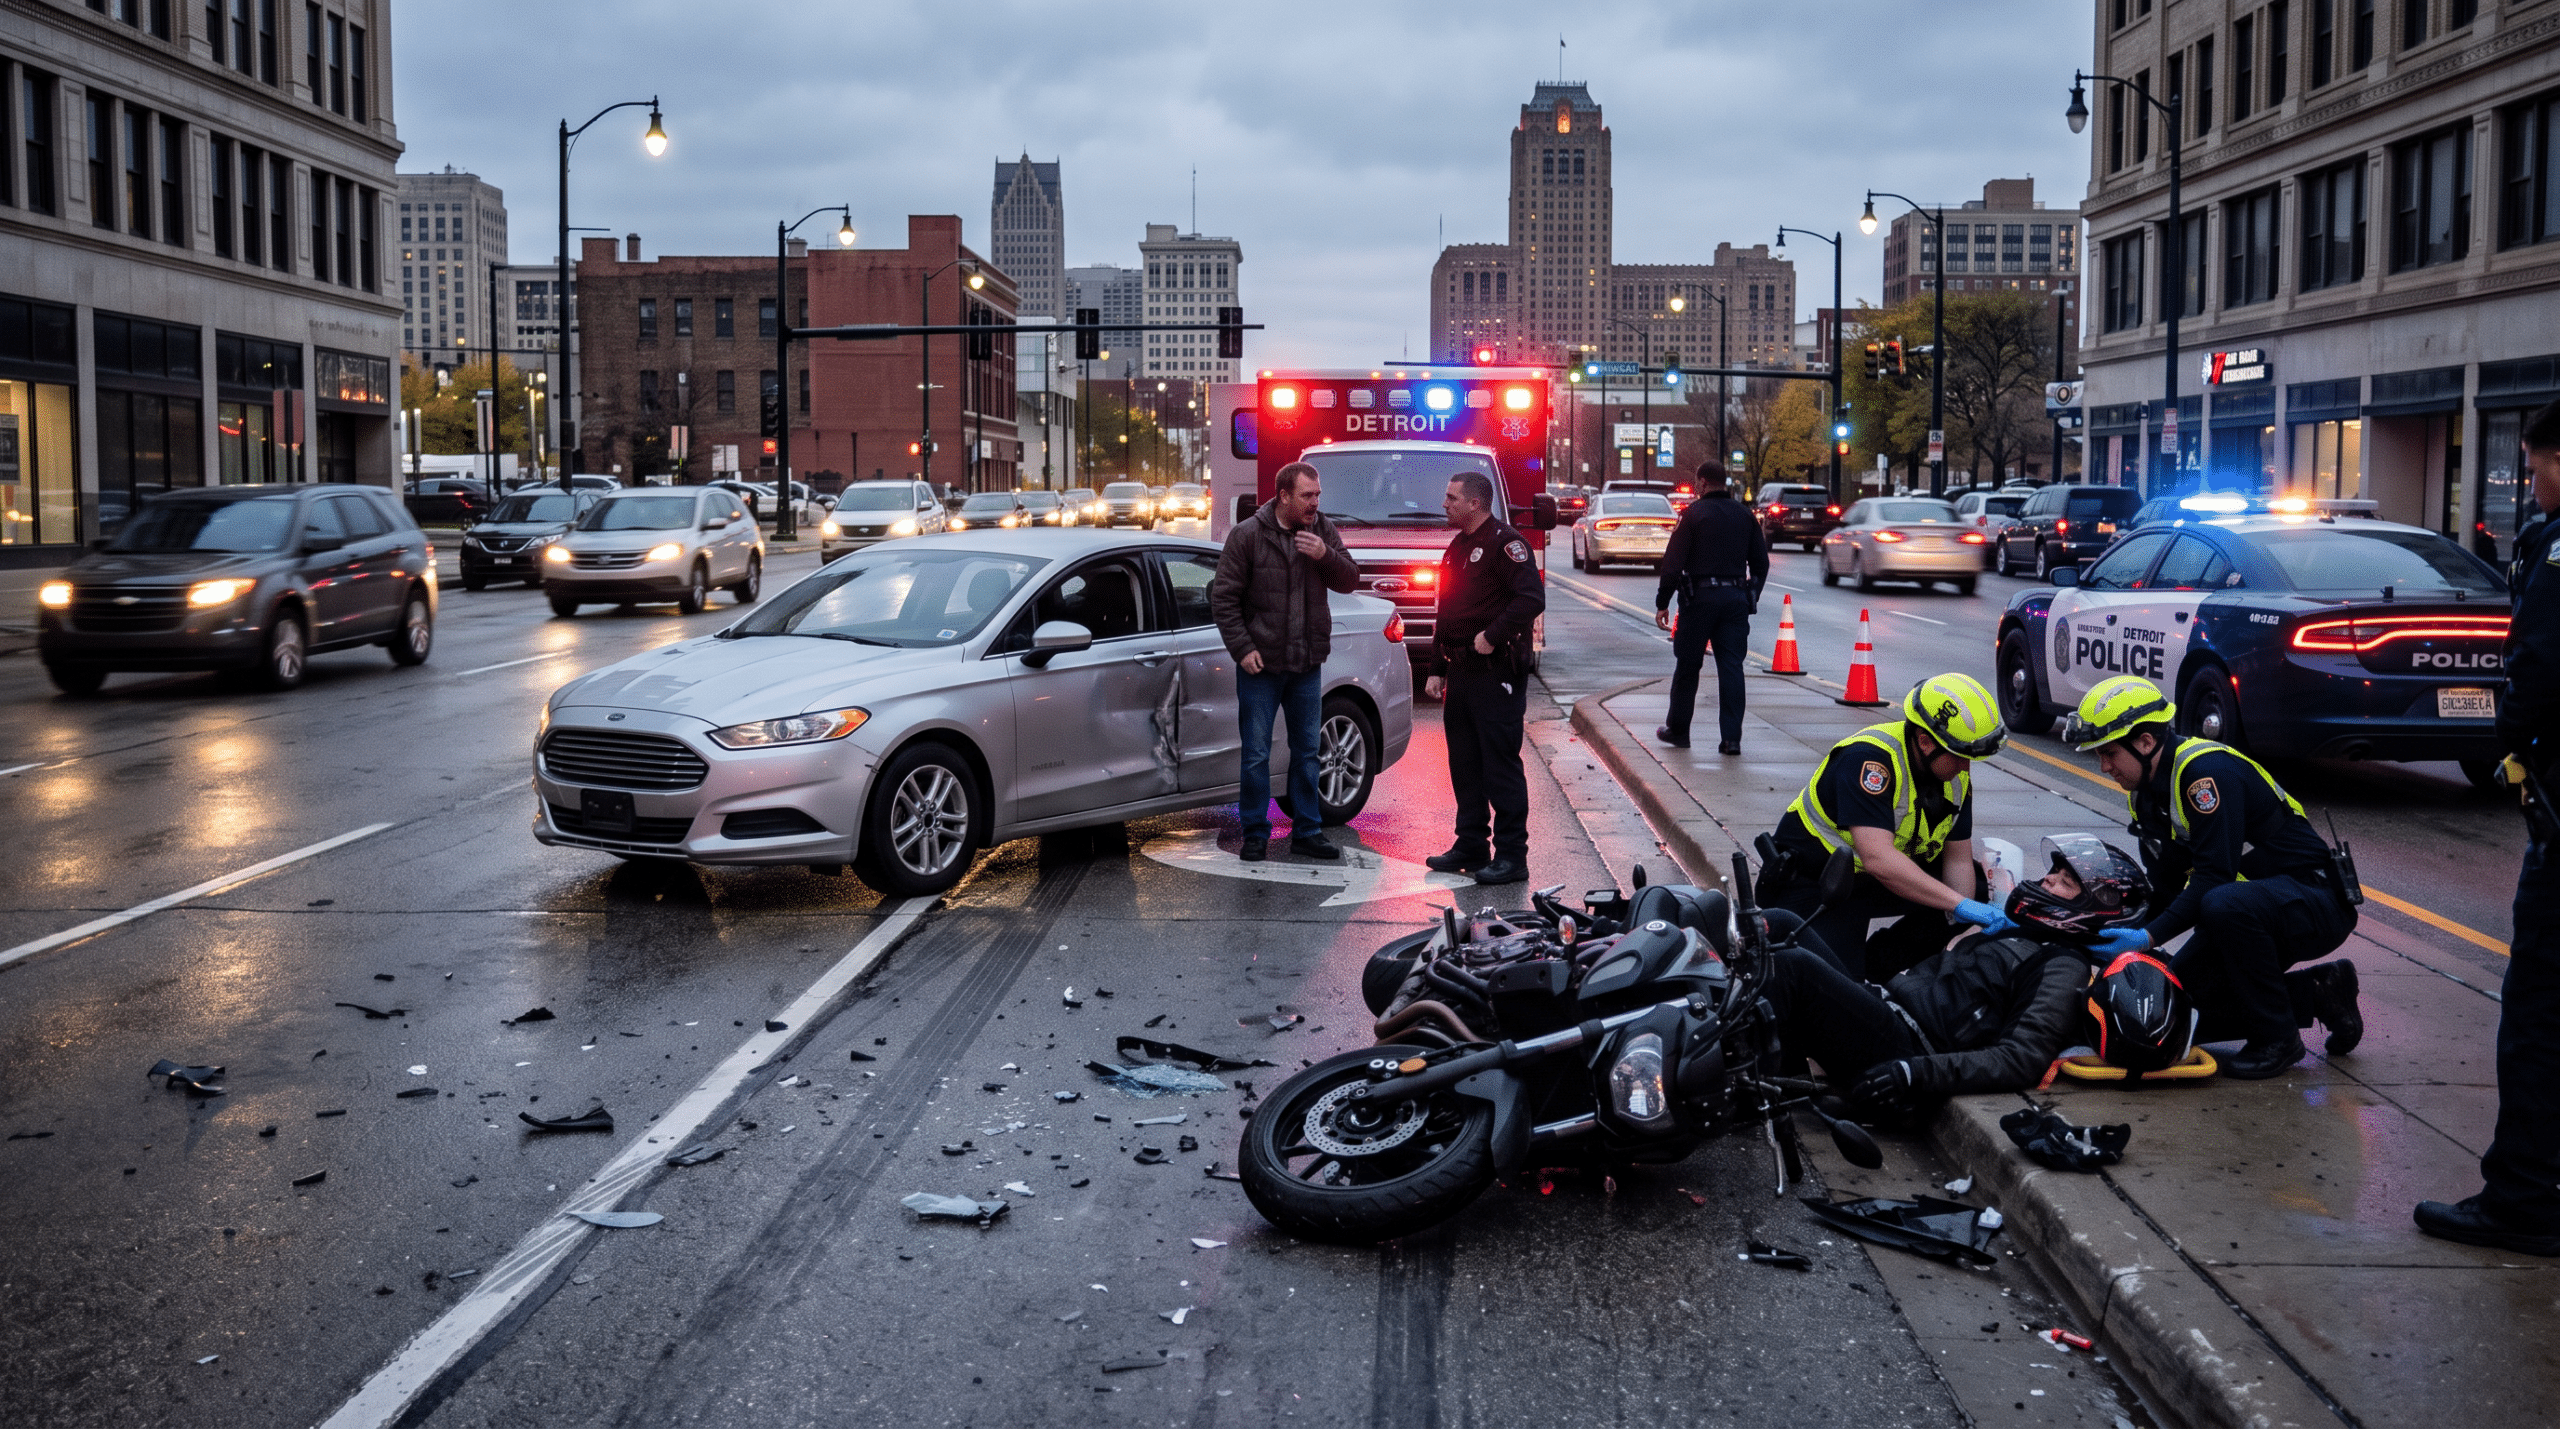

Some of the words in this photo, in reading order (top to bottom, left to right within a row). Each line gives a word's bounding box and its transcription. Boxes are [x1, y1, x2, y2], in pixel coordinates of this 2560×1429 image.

[1346, 414, 1450, 432] DETROIT
[2123, 627, 2166, 644] DETROIT
[2076, 636, 2165, 680] POLICE
[2412, 653, 2505, 669] POLIC
